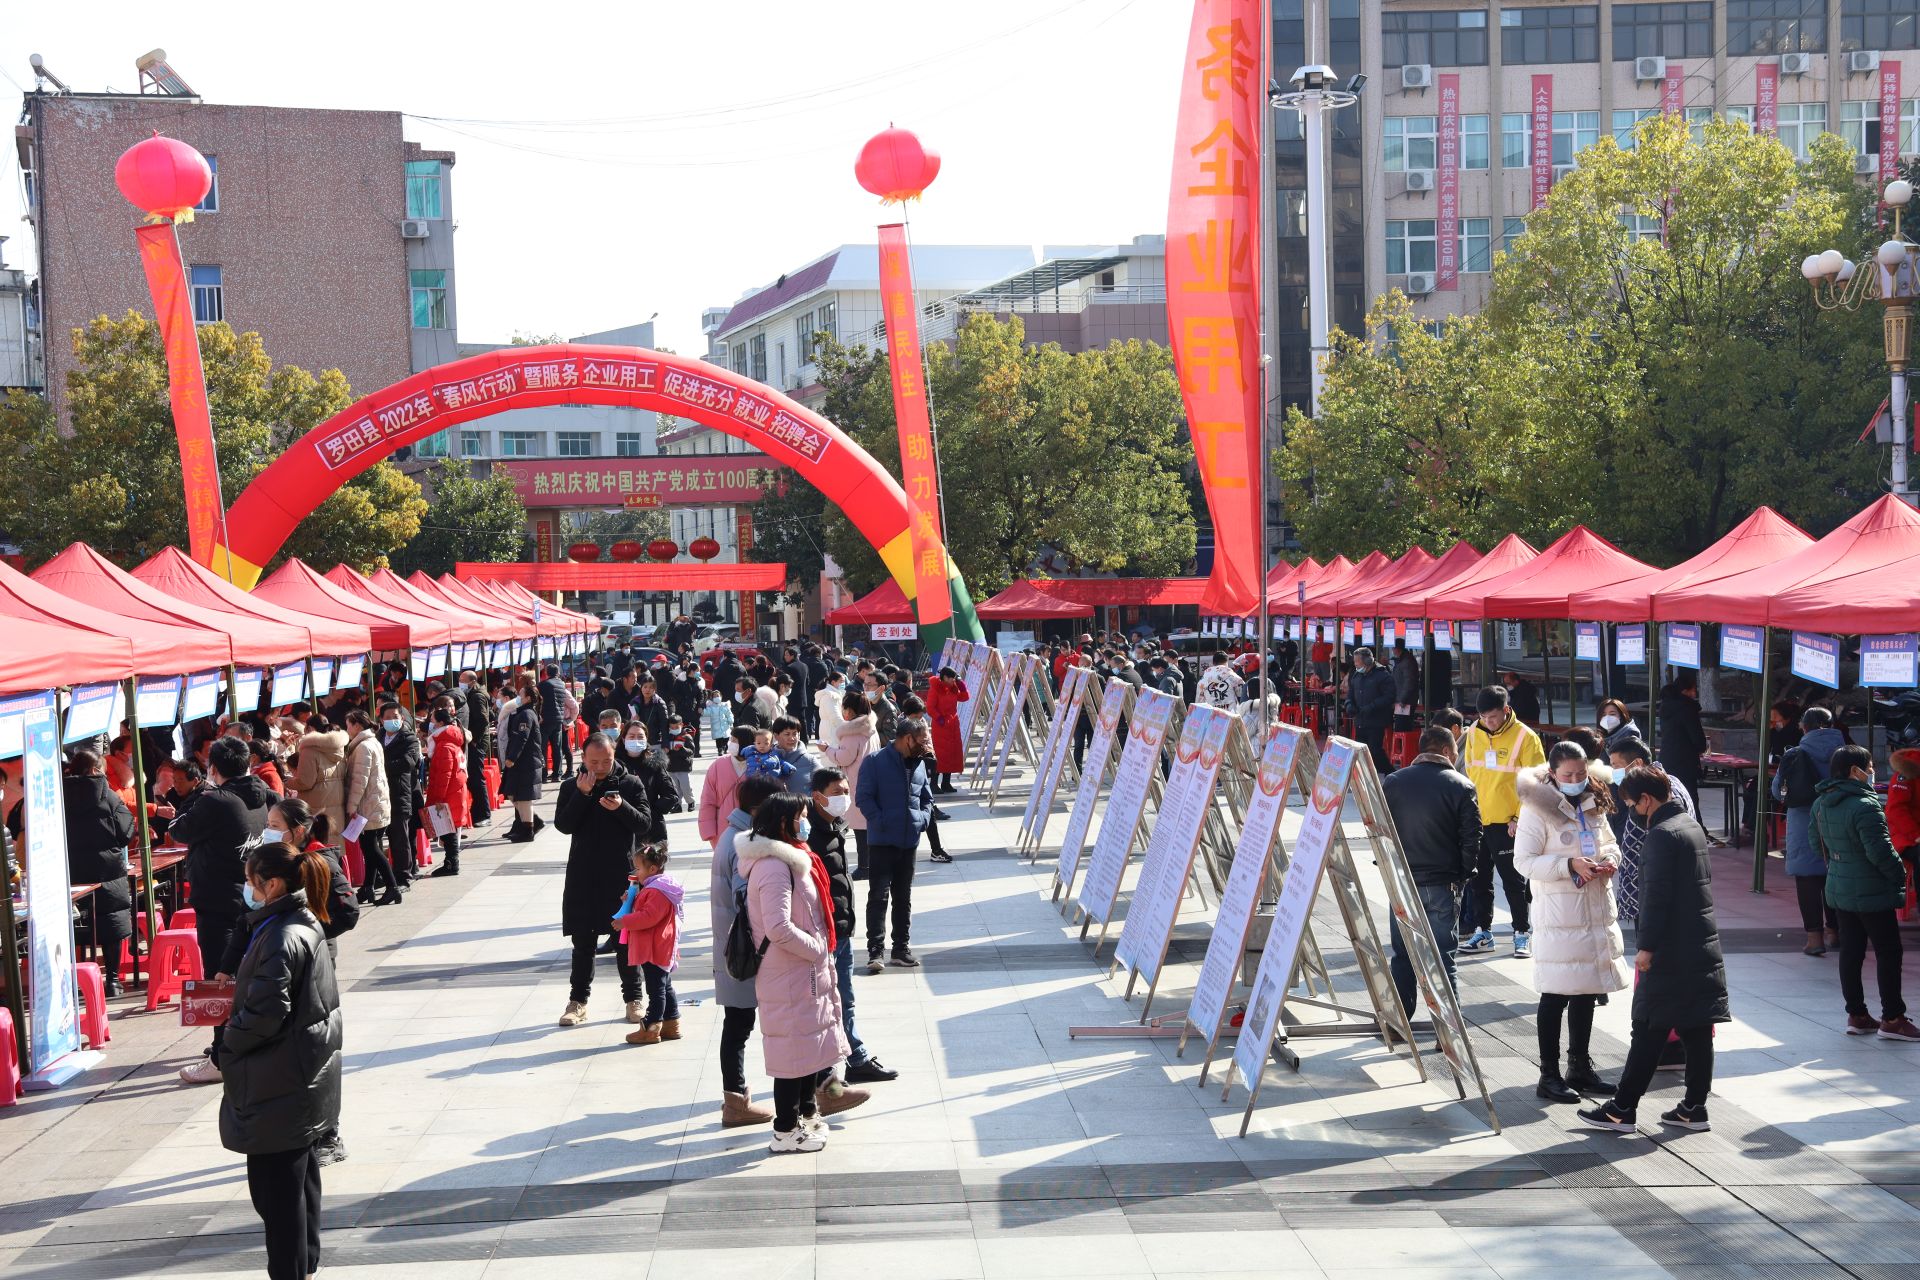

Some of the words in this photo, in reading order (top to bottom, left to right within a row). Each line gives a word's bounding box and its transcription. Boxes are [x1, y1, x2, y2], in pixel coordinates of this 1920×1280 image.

[1882, 73, 1896, 134] 坚持党的领导
[1441, 87, 1456, 280] 热烈庆祝中国共产党成立100周年
[906, 433, 941, 577] 助力发展
[877, 626, 912, 638] 签到处
